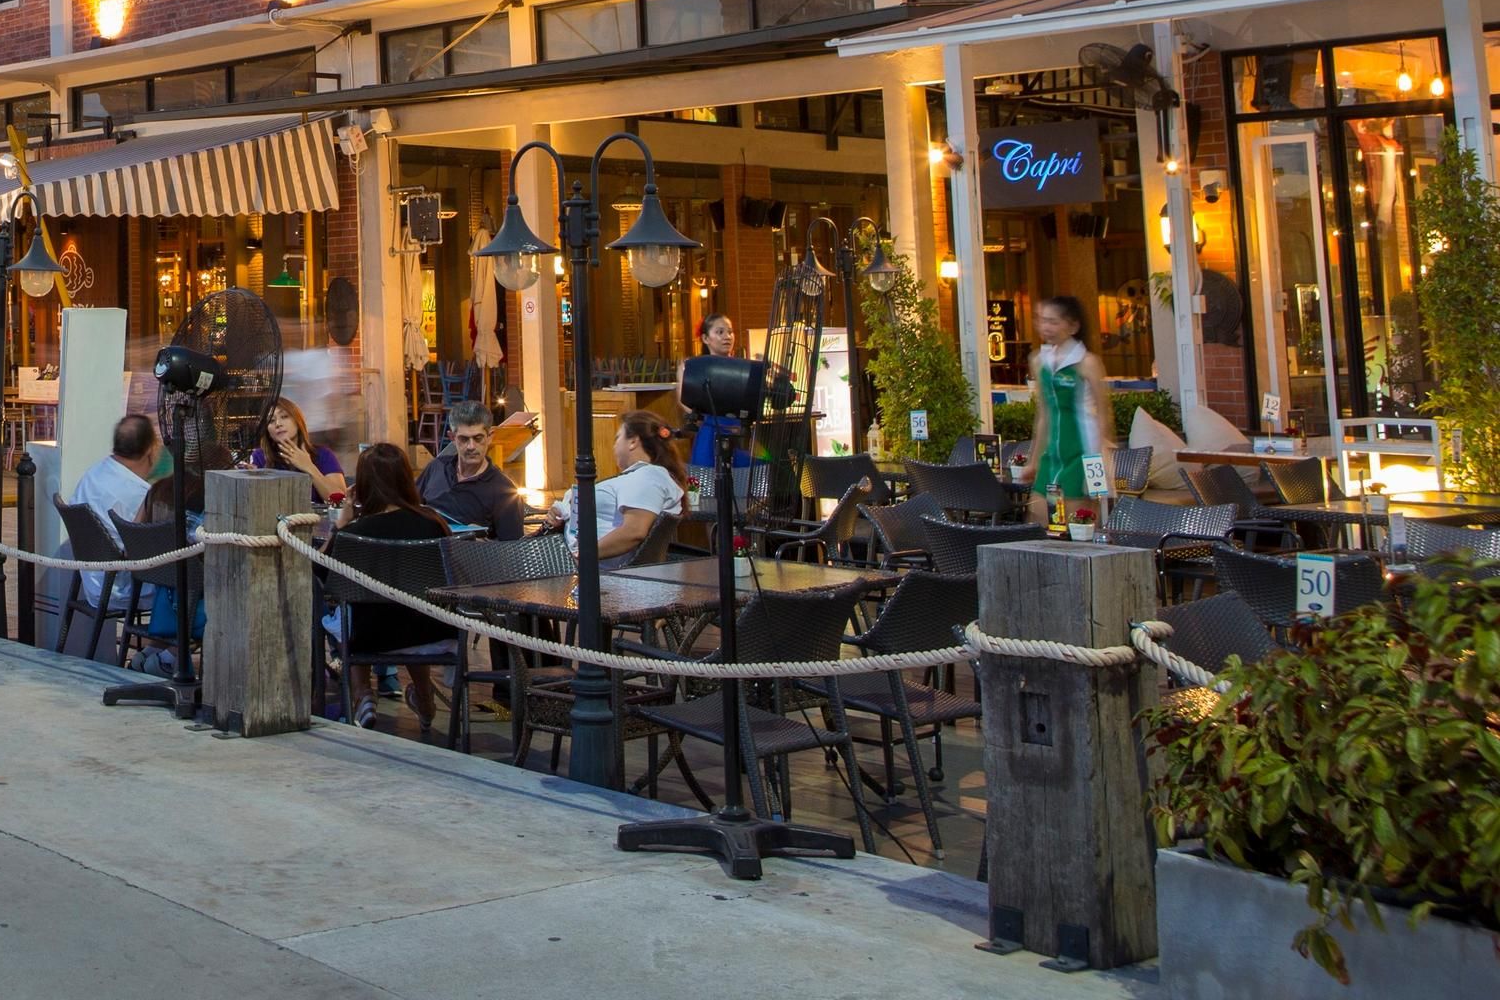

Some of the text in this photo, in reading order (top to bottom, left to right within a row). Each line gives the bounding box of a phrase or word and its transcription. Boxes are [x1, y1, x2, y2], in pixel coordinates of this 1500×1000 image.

[993, 138, 1084, 190] Capri
[1265, 398, 1279, 411] 12
[912, 416, 926, 428] 56
[1086, 463, 1104, 480] 53
[1300, 568, 1331, 597] 50
